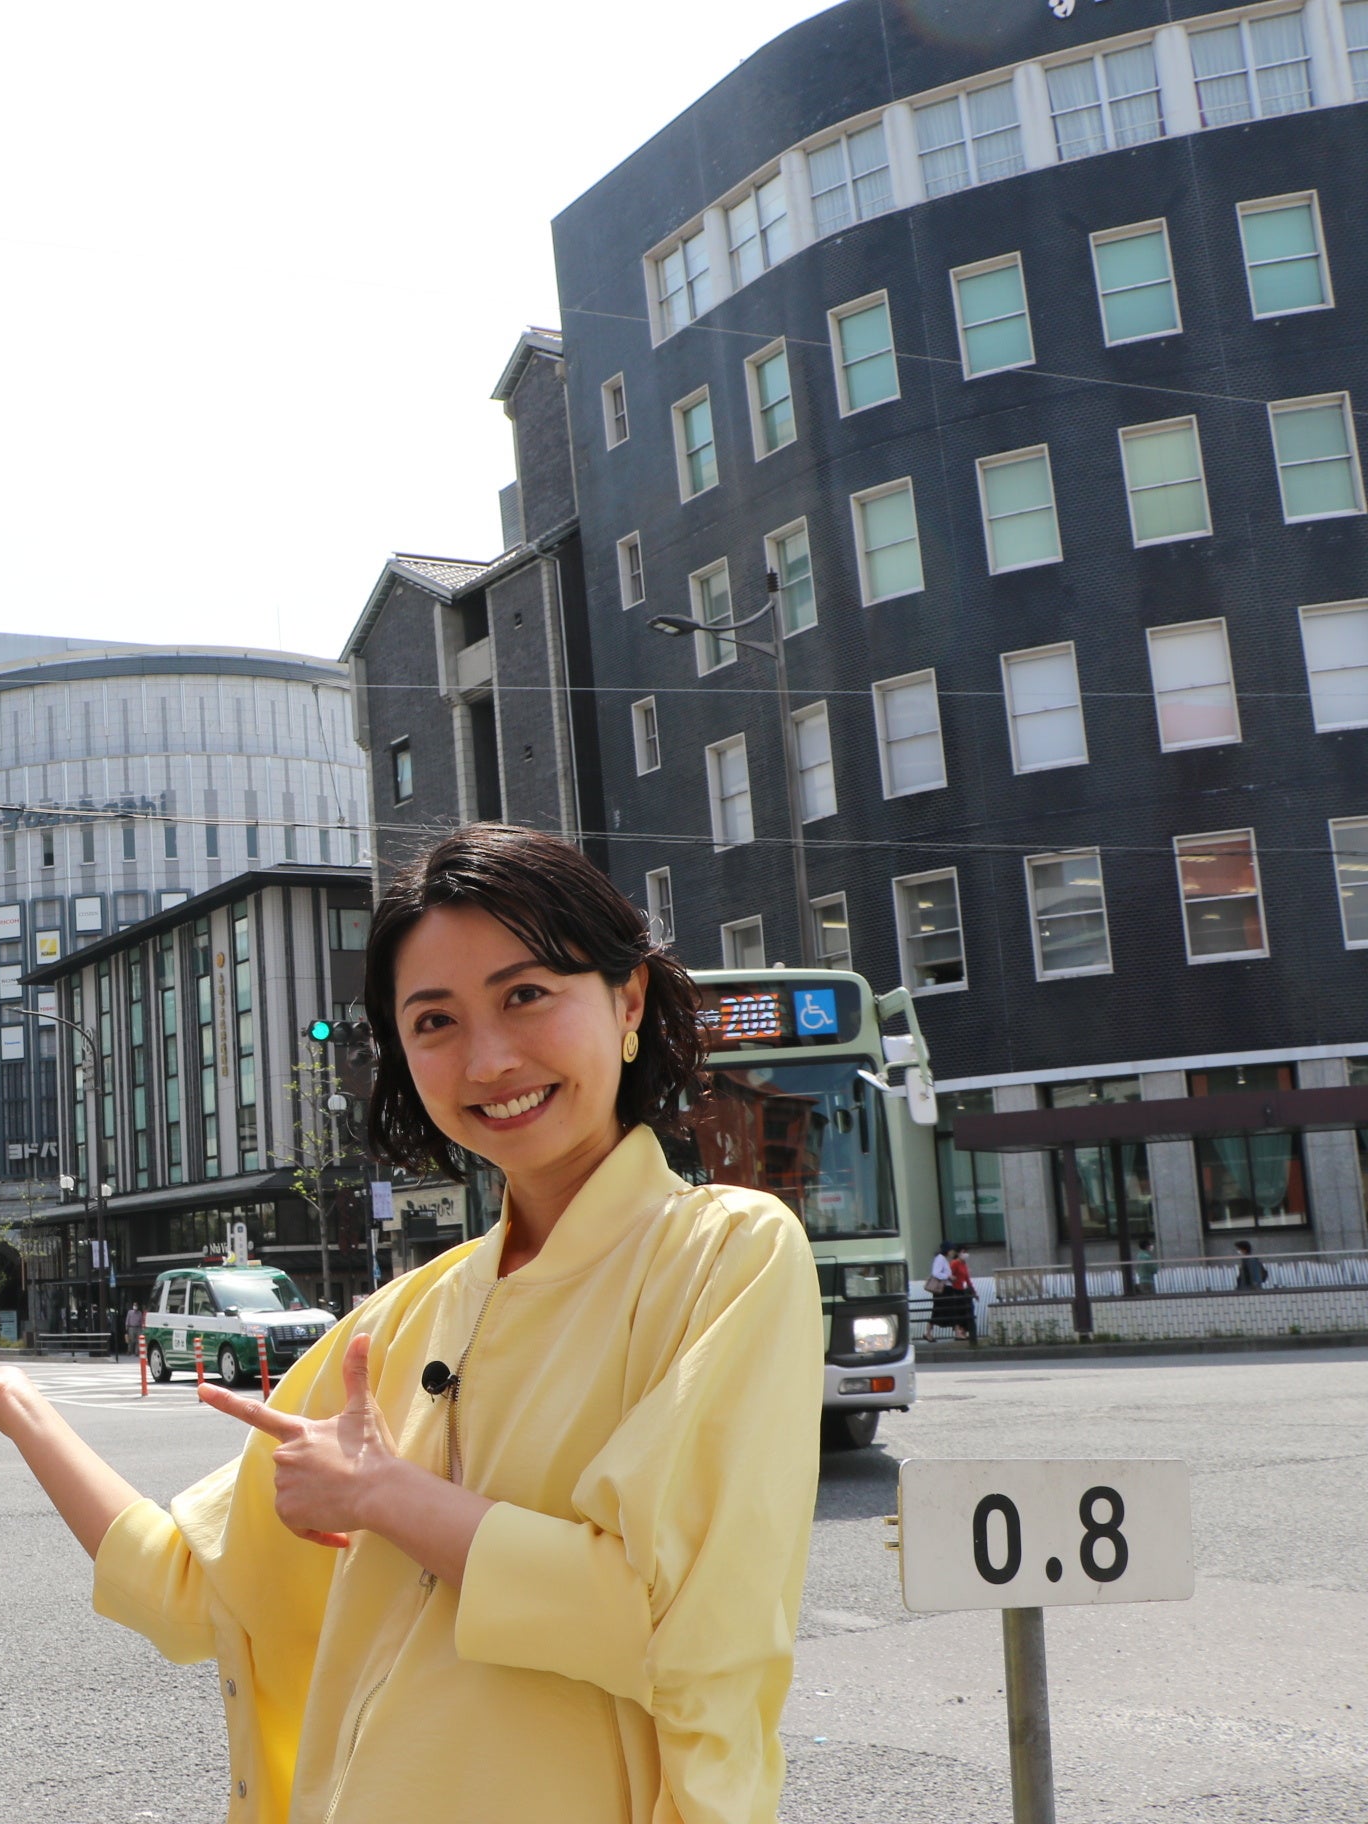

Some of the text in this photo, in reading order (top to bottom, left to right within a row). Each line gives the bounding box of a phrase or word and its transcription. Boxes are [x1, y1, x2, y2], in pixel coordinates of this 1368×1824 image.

[722, 995, 777, 1037] 208
[8, 1141, 58, 1160] ヨドバ
[972, 1485, 1129, 1585] 0.8
